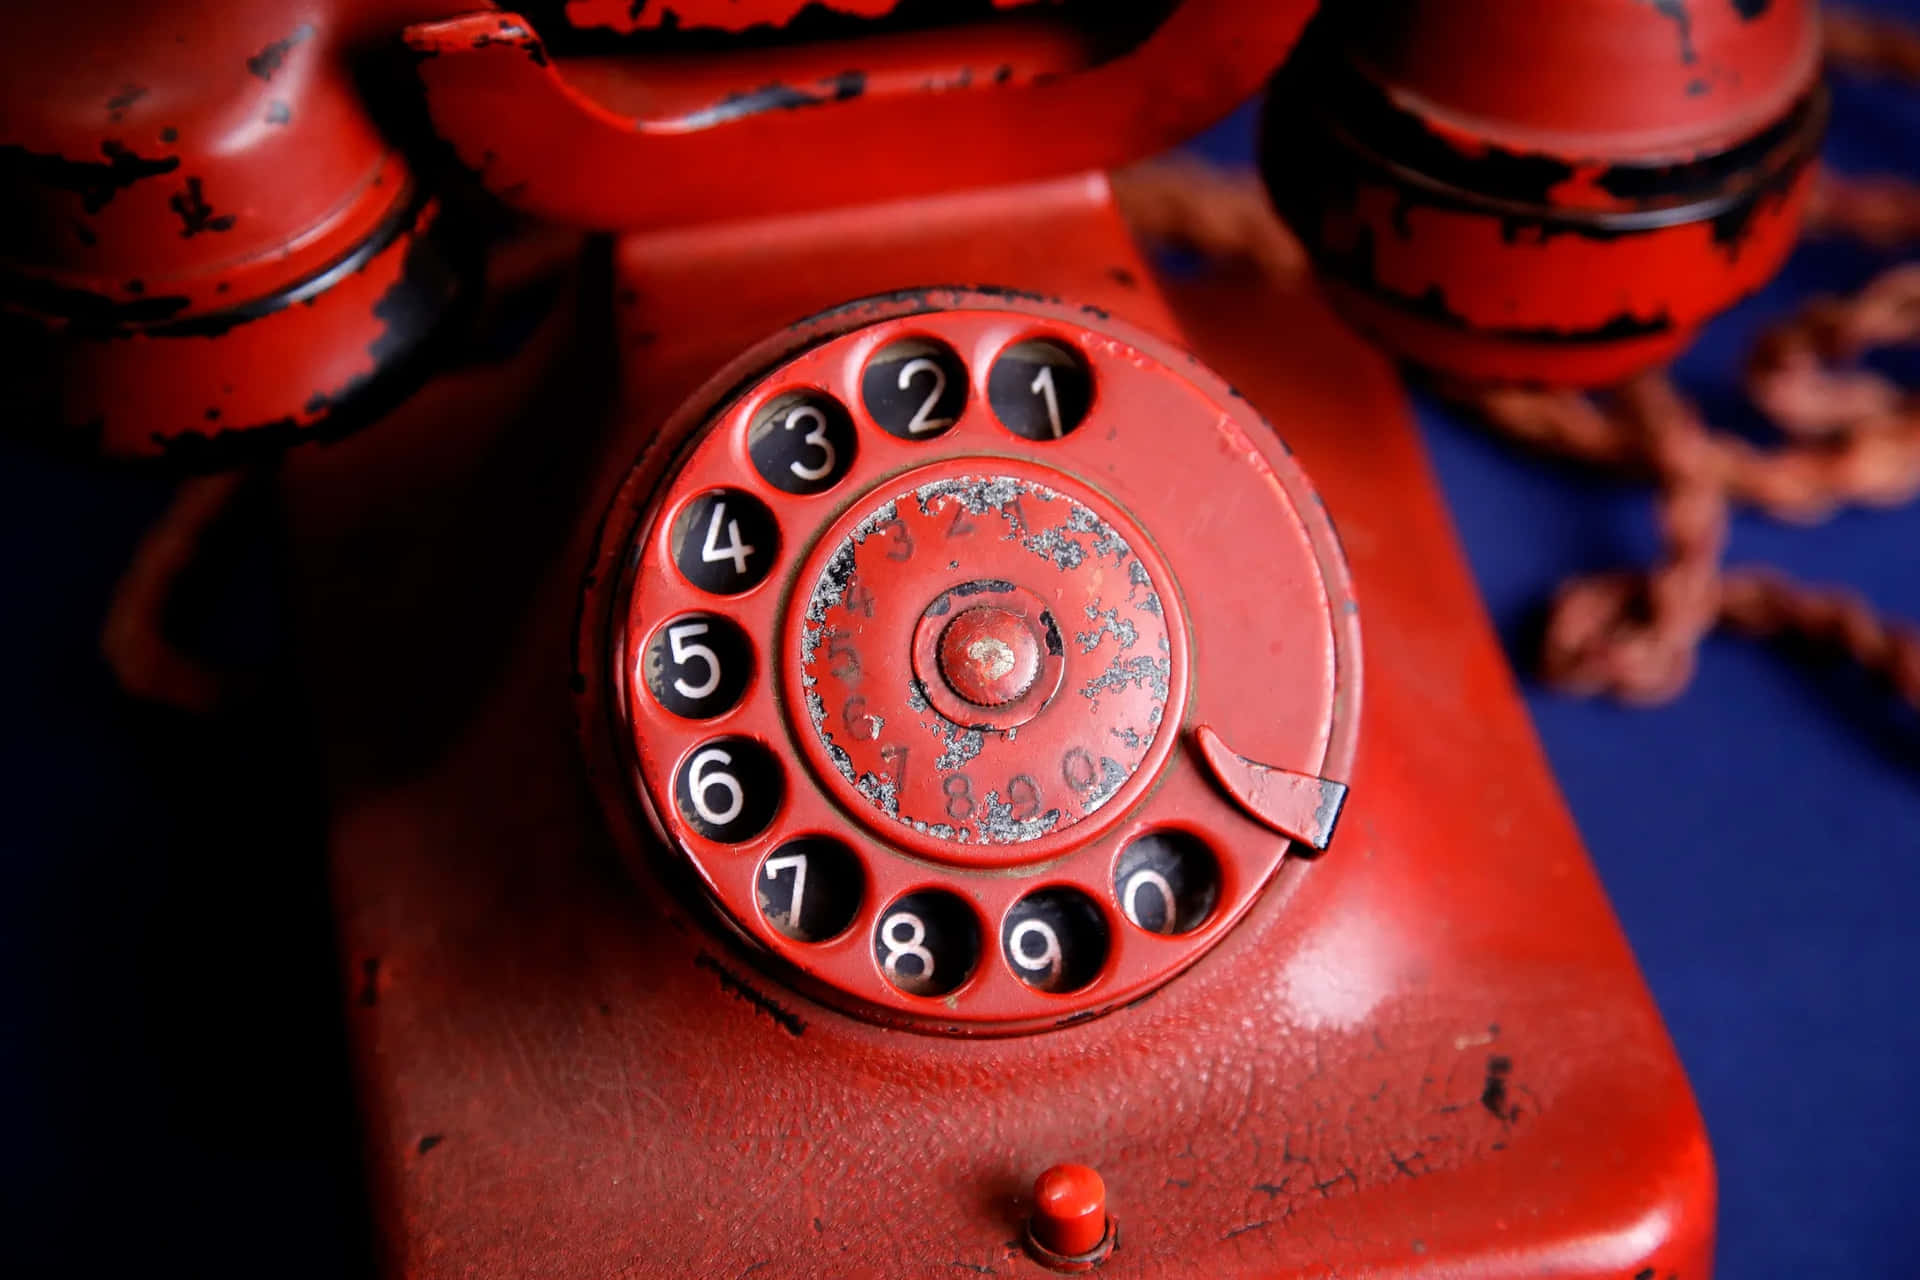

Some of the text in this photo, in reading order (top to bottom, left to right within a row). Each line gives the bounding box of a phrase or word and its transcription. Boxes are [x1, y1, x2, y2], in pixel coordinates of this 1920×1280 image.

[898, 358, 952, 433] 2
[1031, 366, 1063, 438] 1
[785, 405, 835, 480] 3
[701, 502, 755, 574] 4
[879, 519, 915, 562] 3
[668, 623, 721, 699] 5
[688, 748, 744, 825] 6
[943, 773, 975, 819] 8
[1007, 775, 1041, 820] 9
[1062, 746, 1098, 791] 0
[765, 854, 808, 928] 7
[1123, 868, 1177, 935] 0
[880, 911, 934, 983] 8
[1010, 918, 1063, 988] 9
